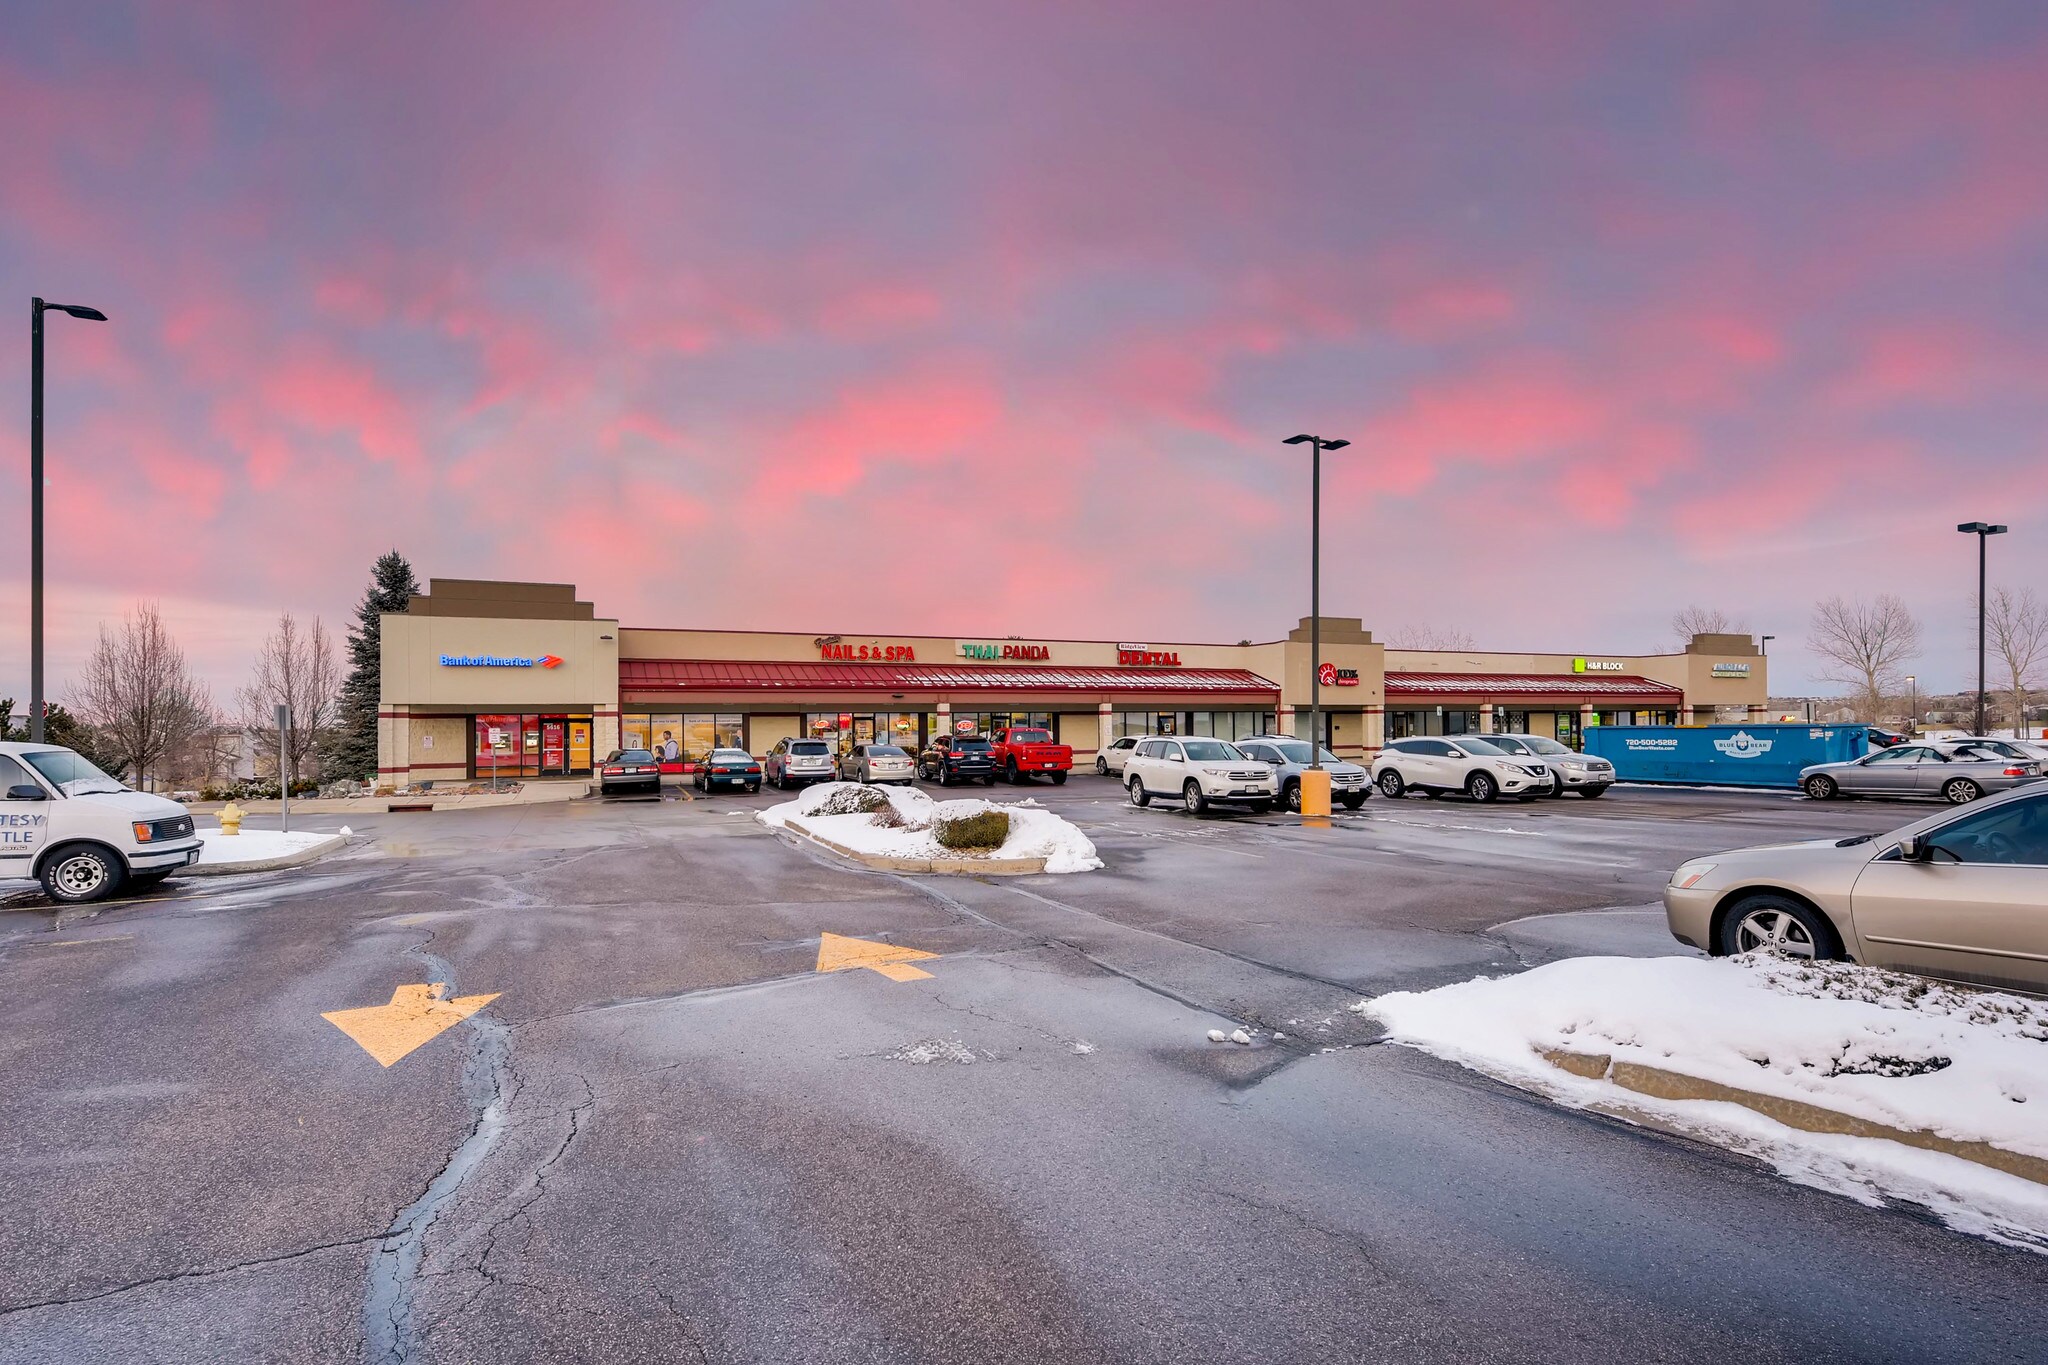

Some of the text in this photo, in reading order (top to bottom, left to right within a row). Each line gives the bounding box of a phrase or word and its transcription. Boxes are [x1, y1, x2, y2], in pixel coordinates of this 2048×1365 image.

[821, 644, 915, 661] NAILS & SPA
[962, 644, 1050, 660] THAI PANDA
[1119, 651, 1182, 666] DENTAL
[440, 654, 533, 667] Bank of America
[1587, 662, 1624, 670] H&R BLOCK
